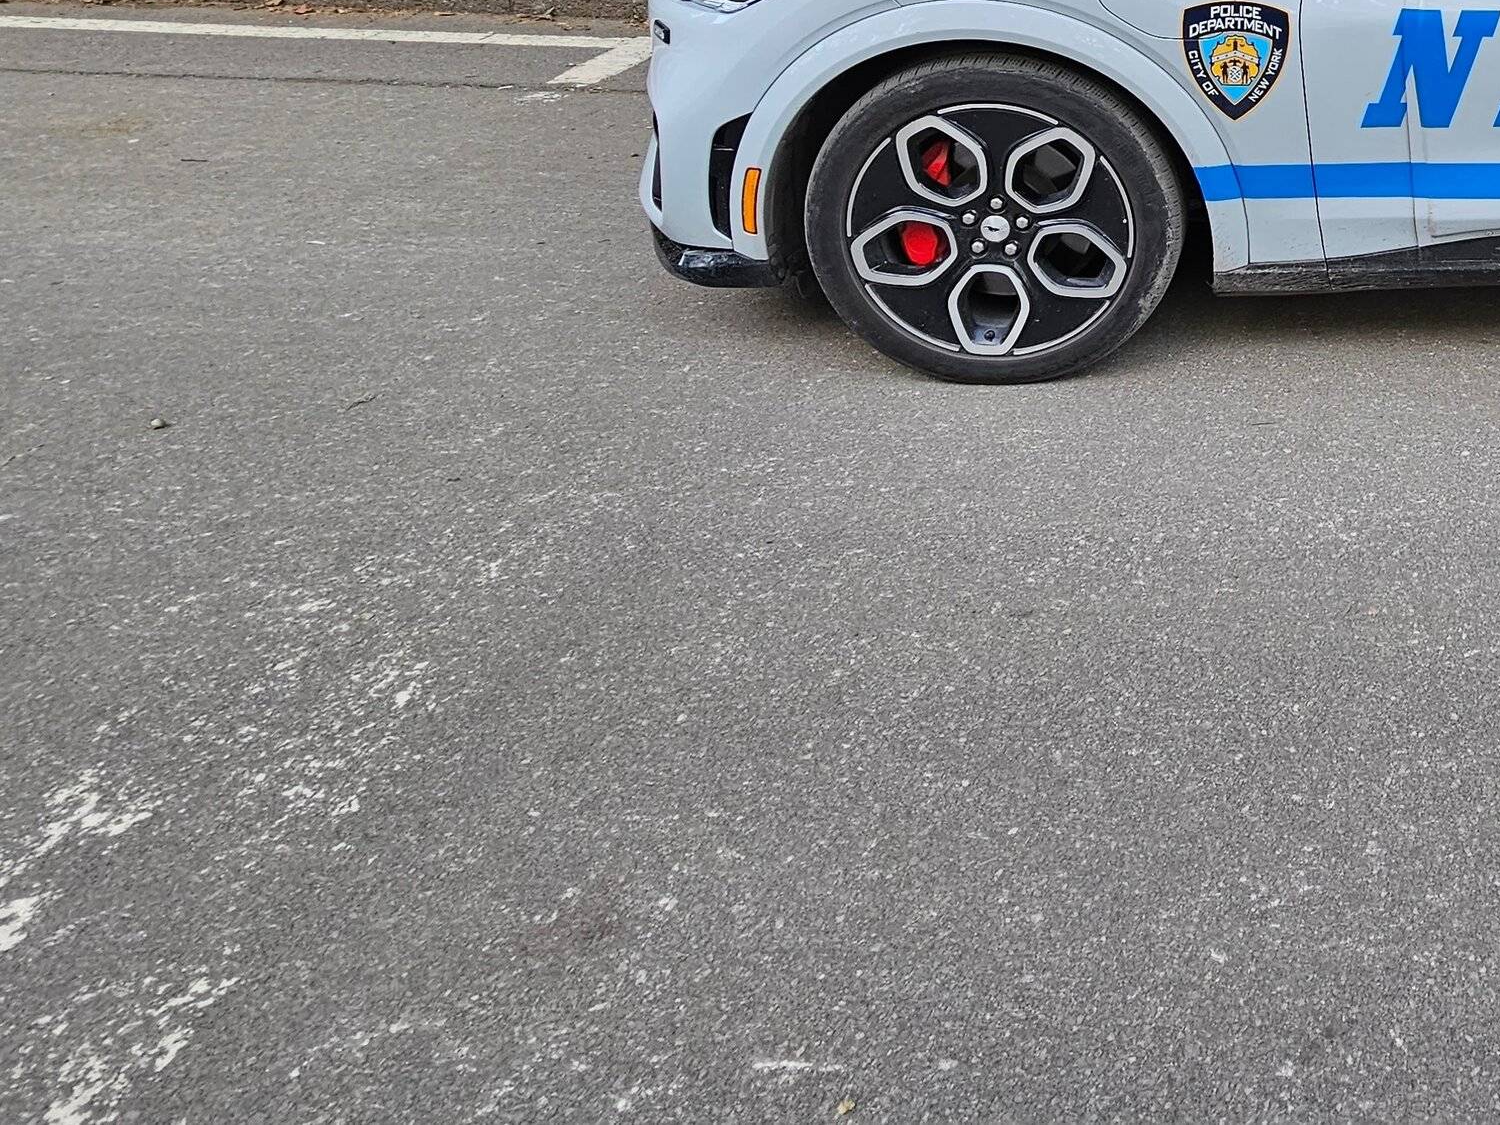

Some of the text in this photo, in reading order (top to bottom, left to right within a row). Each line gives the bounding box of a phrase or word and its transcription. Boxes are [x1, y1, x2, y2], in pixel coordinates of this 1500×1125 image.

[1189, 17, 1282, 40] DEPARTMENT
[1210, 5, 1262, 19] POLICE
[1188, 50, 1219, 96] CITY OF
[1248, 48, 1283, 103] NEW YORK
